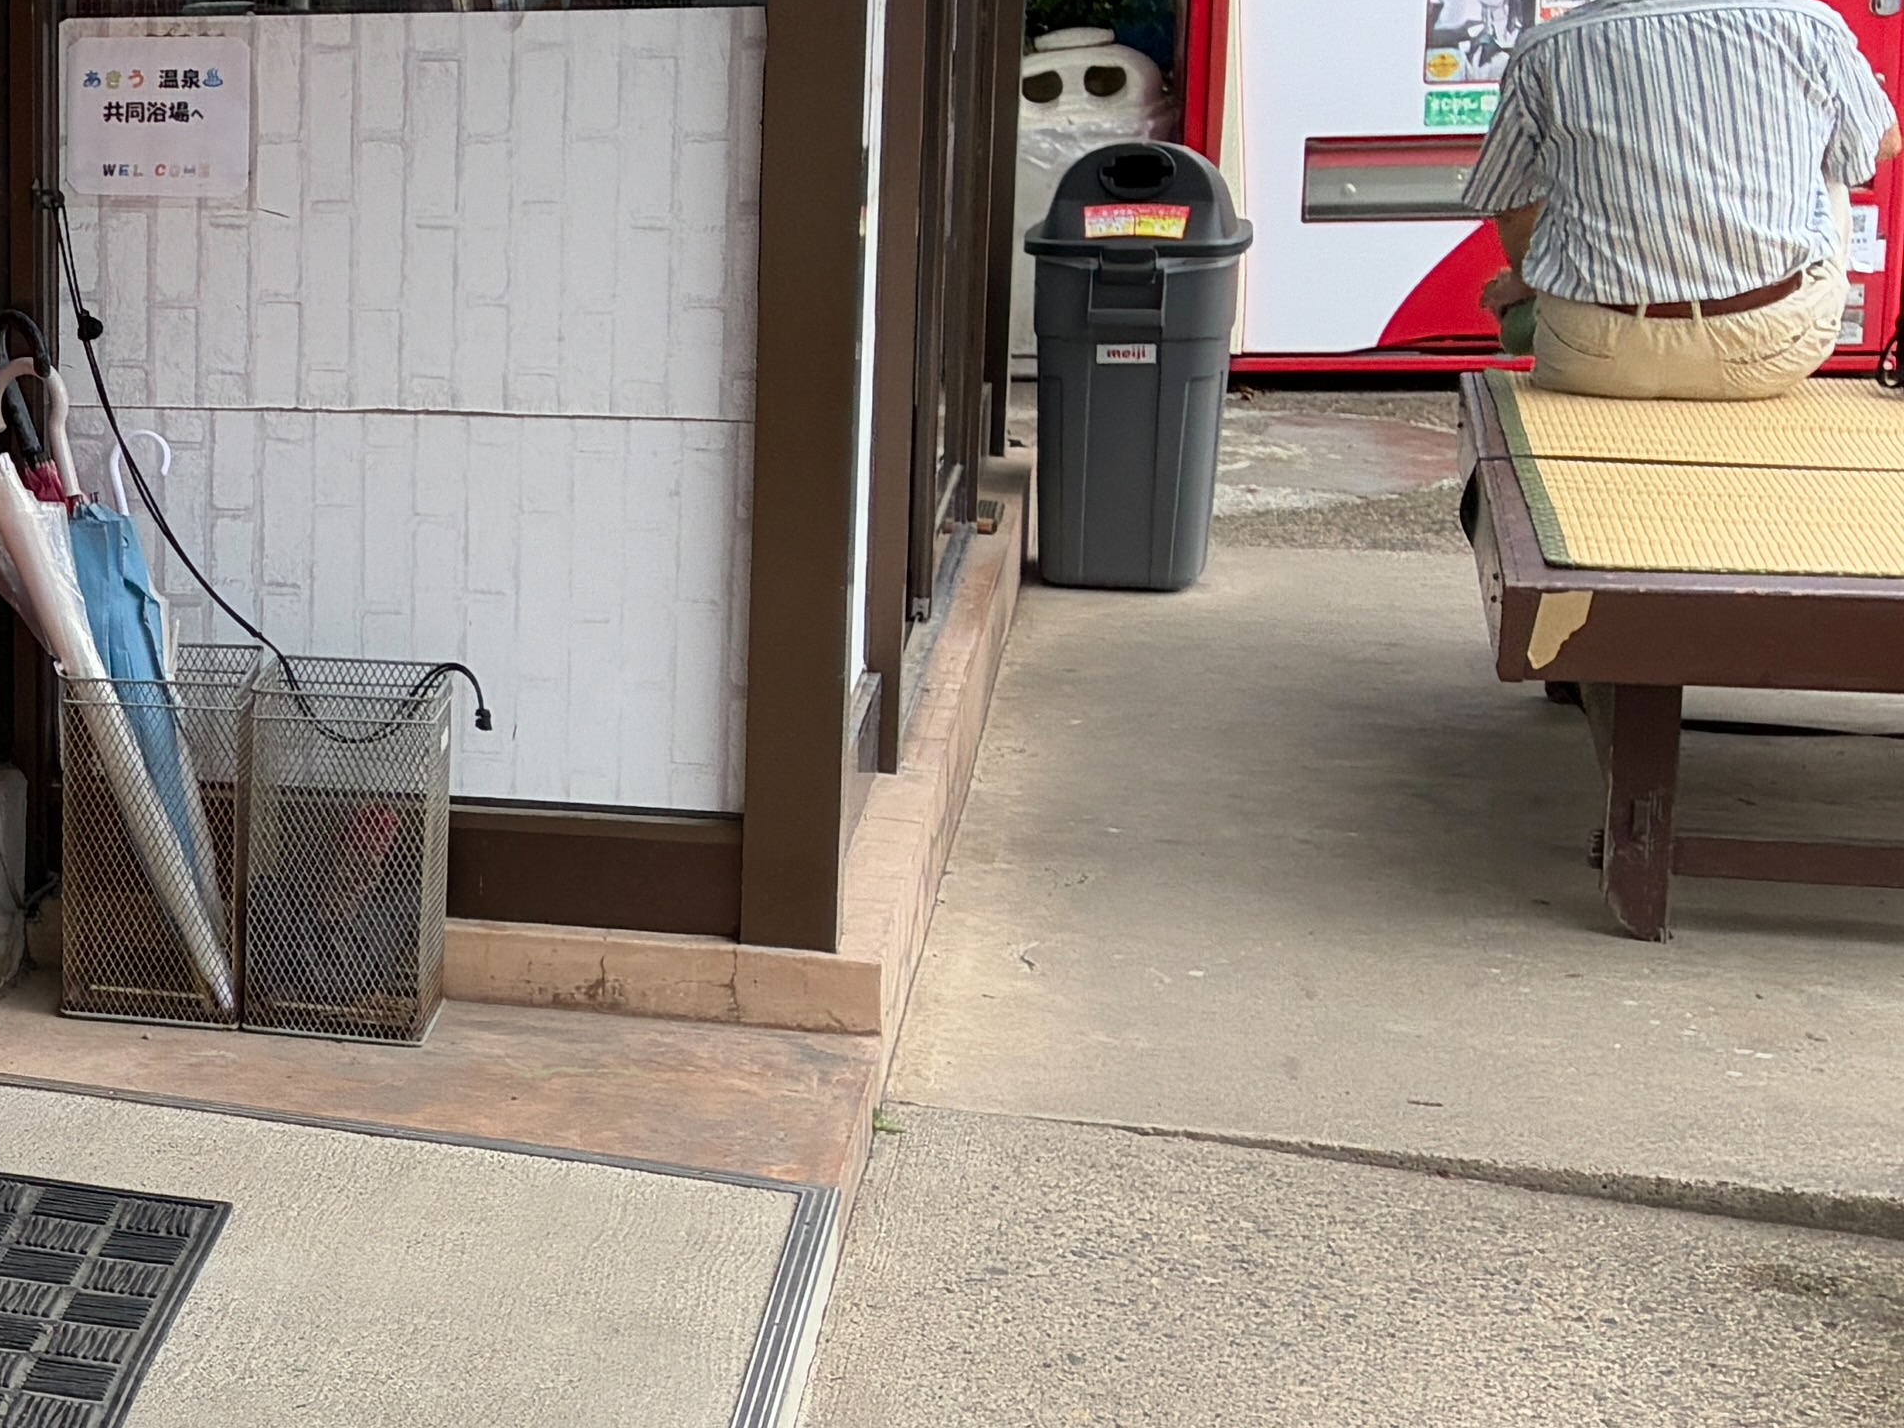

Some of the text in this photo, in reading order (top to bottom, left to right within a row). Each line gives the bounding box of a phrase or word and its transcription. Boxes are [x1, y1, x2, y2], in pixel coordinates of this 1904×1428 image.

[158, 69, 201, 89] 温泉
[103, 101, 204, 123] 共同浴場へ
[1107, 344, 1147, 361] meiji
